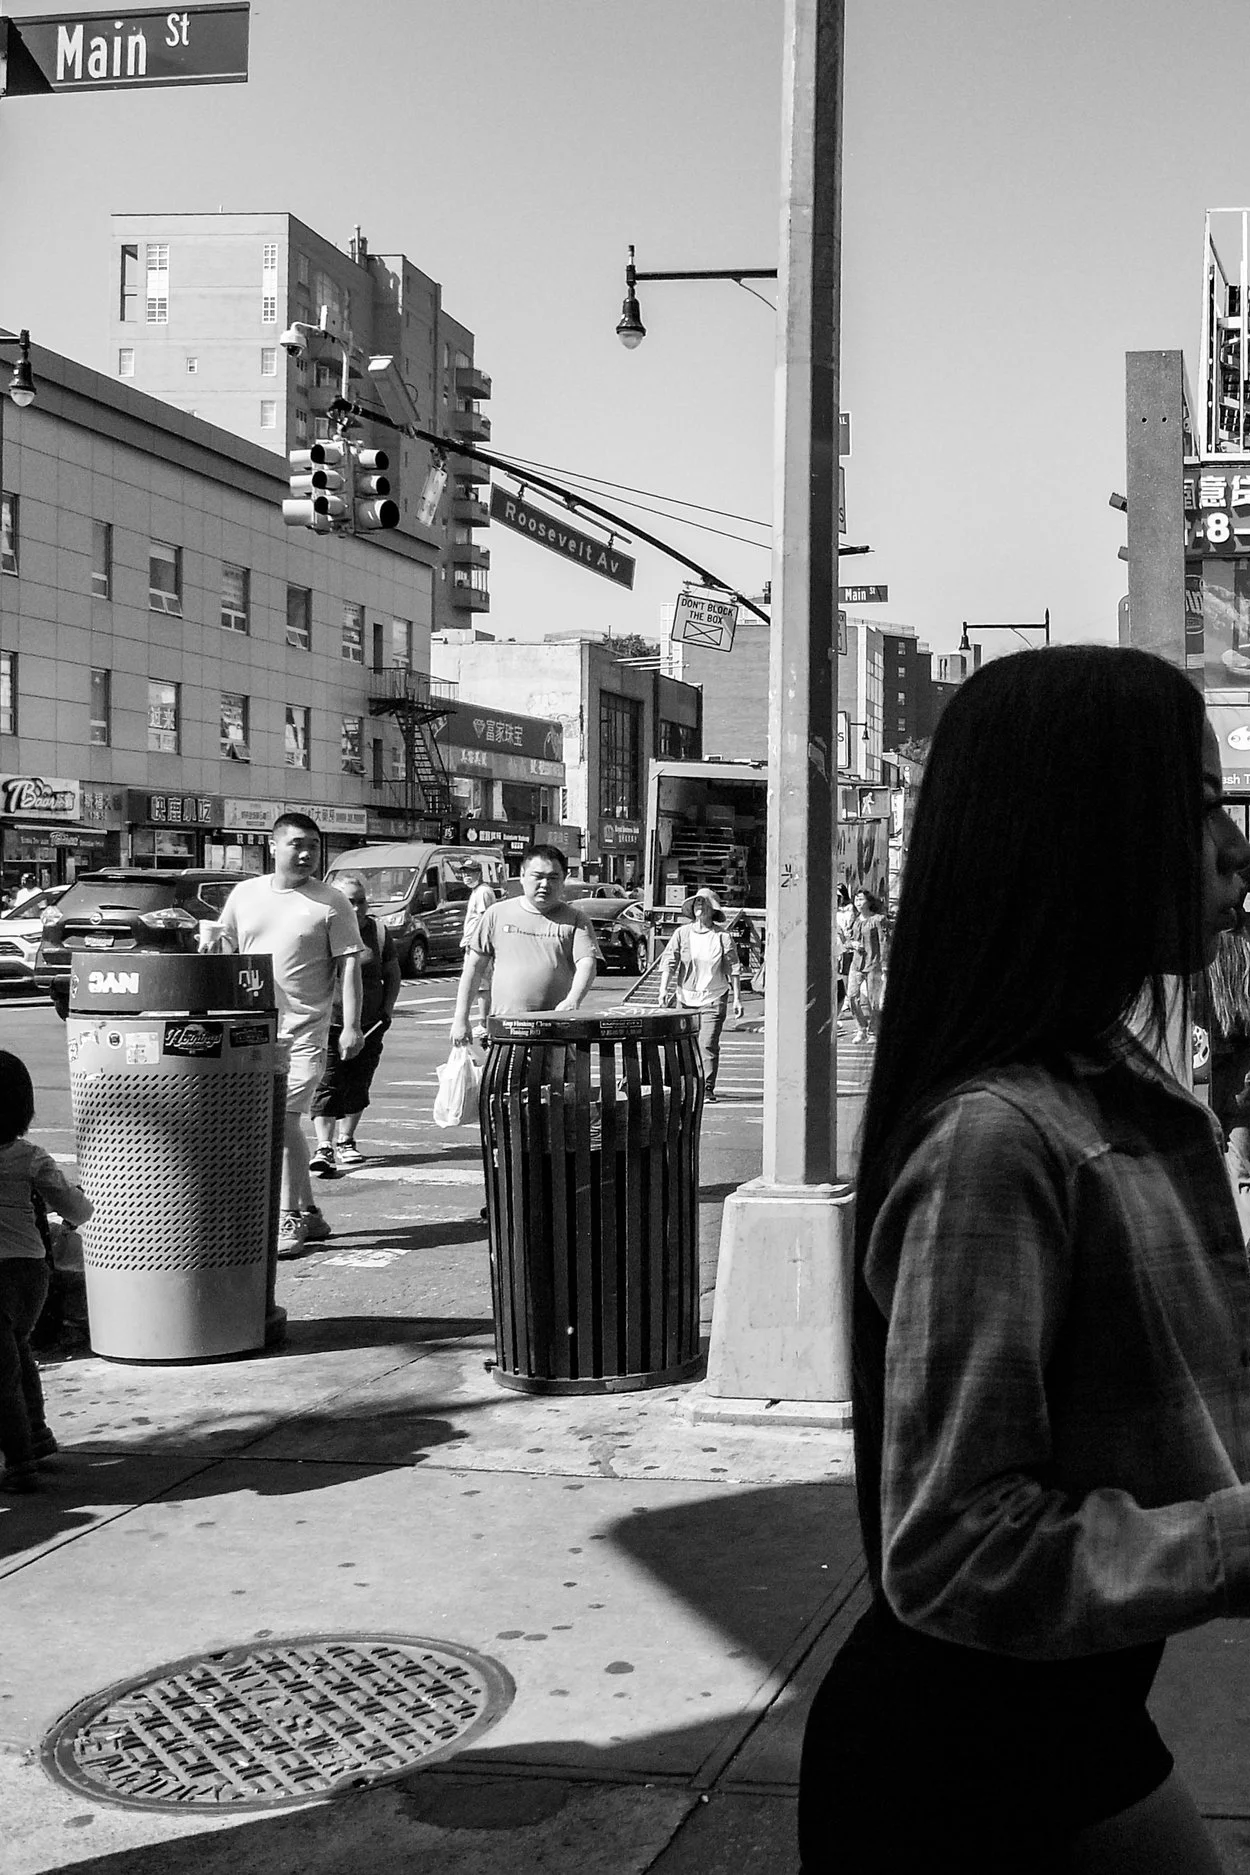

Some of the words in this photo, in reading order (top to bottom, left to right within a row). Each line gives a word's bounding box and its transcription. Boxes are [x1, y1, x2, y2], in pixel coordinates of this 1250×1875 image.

[56, 21, 147, 81] Main
[165, 12, 191, 47] St
[505, 501, 592, 561] Roosevelt
[597, 551, 619, 573] Av
[845, 587, 867, 602] Main
[869, 587, 876, 595] St
[681, 598, 706, 610] DON'T
[707, 603, 734, 617] BLOCK
[690, 610, 705, 621] THE
[707, 614, 724, 625] BOX
